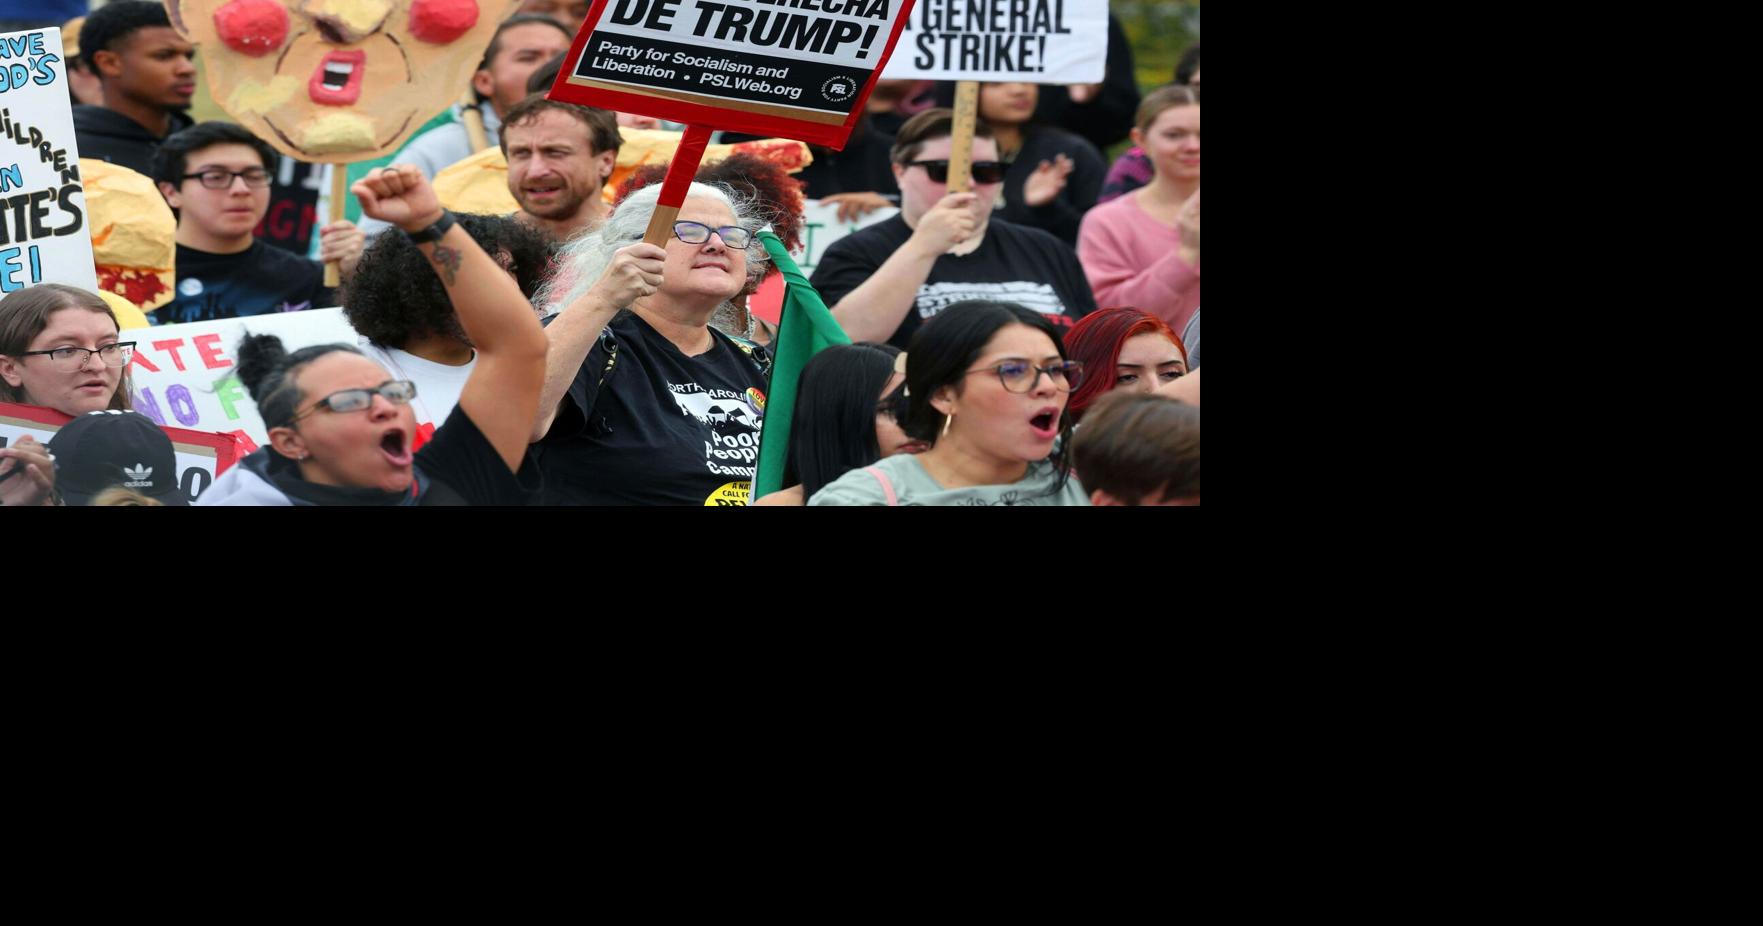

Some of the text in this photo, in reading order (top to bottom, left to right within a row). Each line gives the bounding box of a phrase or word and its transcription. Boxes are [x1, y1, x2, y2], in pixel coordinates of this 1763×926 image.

[610, 0, 880, 60] DE TRUMP!
[921, 0, 1072, 34] GENERAL
[598, 40, 789, 79] Party for Socialism and
[914, 33, 1046, 72] STRIKE!
[591, 57, 676, 79] Liberation
[700, 72, 803, 100] PSLWeb.org
